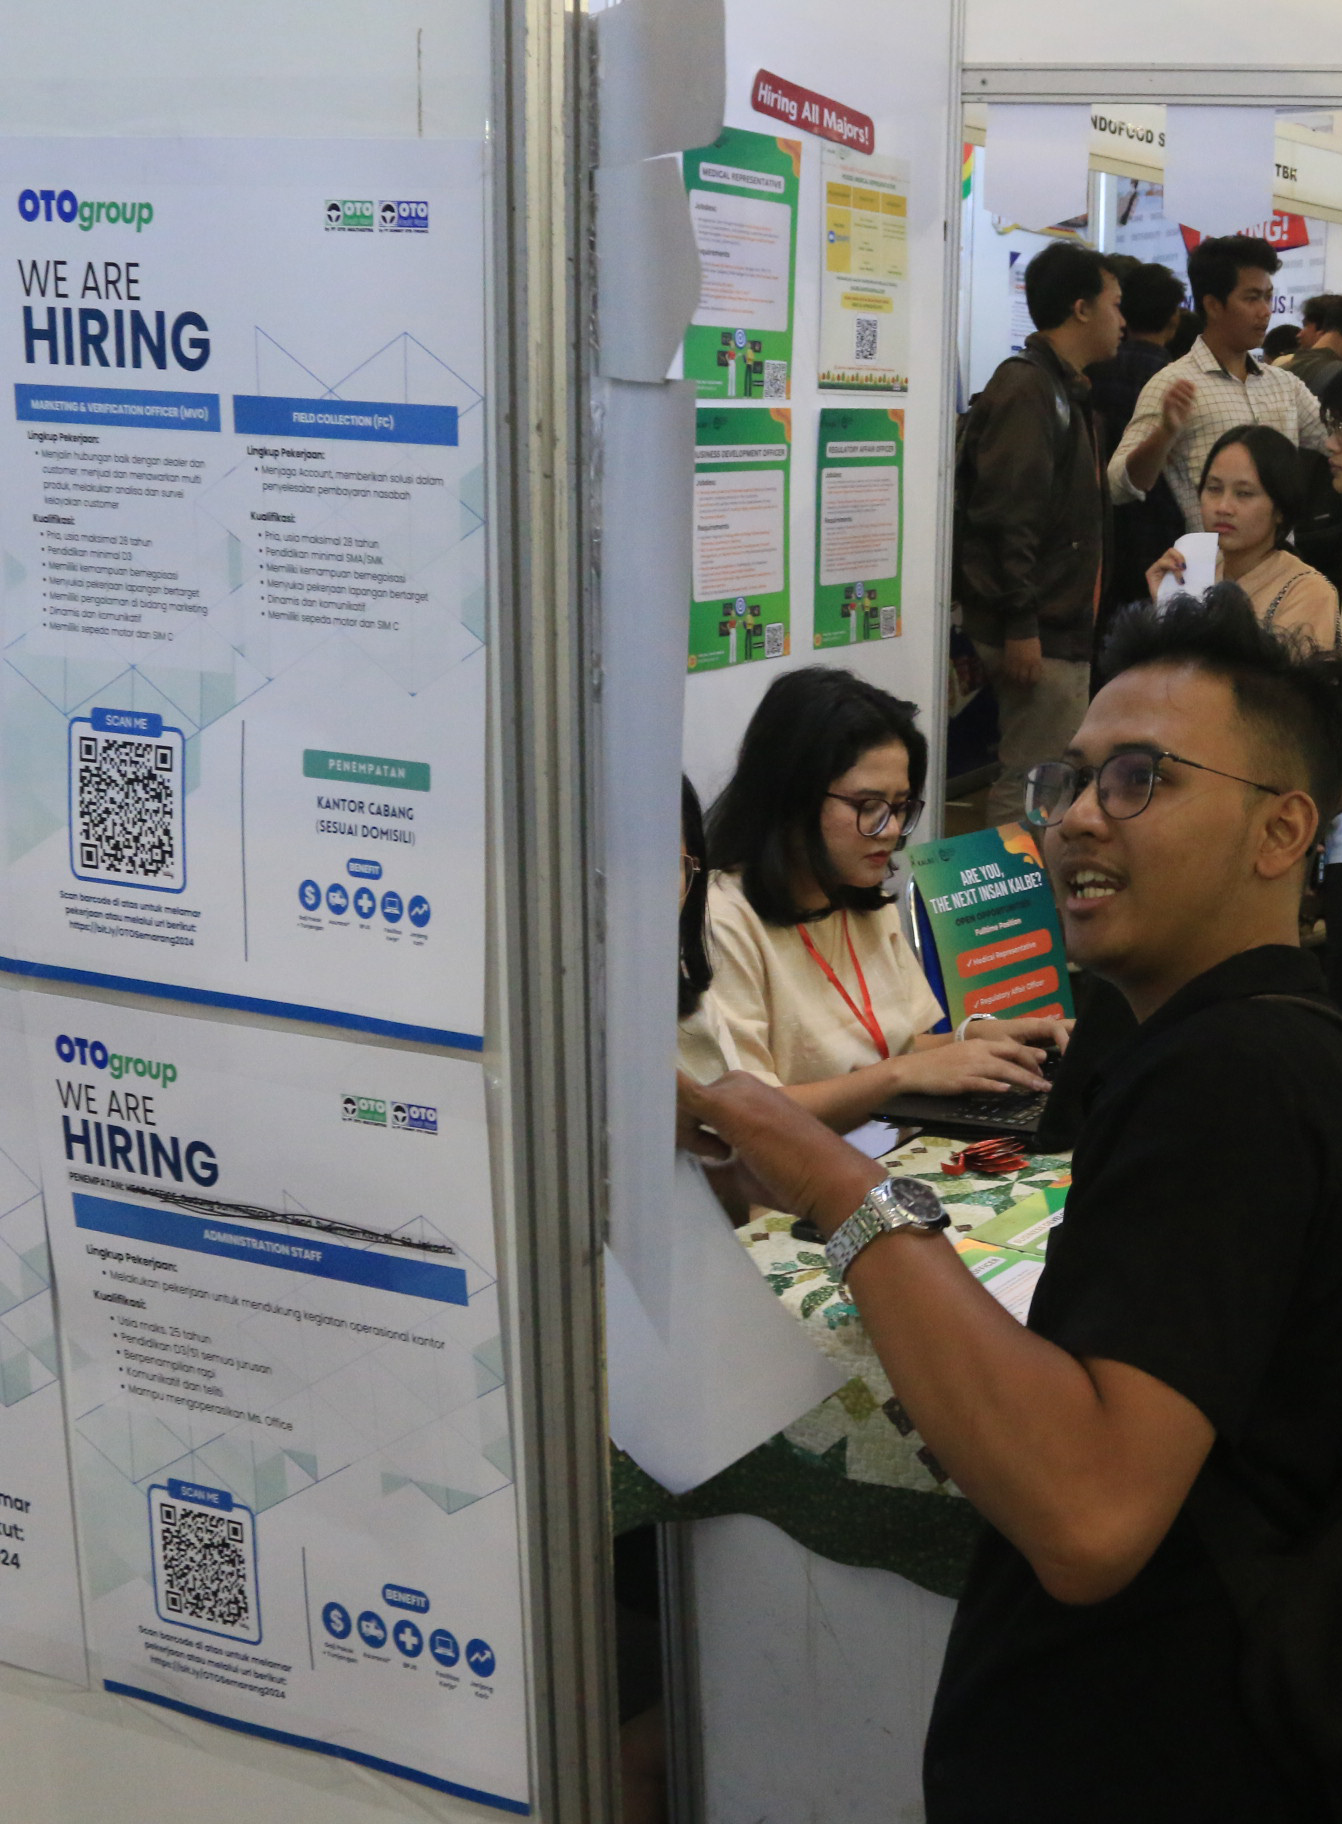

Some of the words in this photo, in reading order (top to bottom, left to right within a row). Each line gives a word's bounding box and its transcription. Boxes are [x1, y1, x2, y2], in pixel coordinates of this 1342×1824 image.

[758, 82, 797, 120] Hiring
[802, 101, 819, 124] All
[823, 108, 869, 144] Majors!
[1158, 132, 1166, 147] S
[703, 168, 730, 179] MEDICAL
[732, 174, 782, 189] REPRESENTATIVE
[1275, 163, 1298, 181] TBK
[18, 188, 154, 232] OTOgroup
[344, 202, 372, 216] OTO
[399, 202, 427, 218] OTO
[18, 259, 69, 298] WE
[81, 262, 141, 301] ARE
[22, 305, 211, 372] HIRING
[30, 399, 79, 411] MARKETING
[78, 402, 86, 412] &
[86, 402, 144, 415] VERIFICATION
[143, 405, 179, 417] OFFICER
[179, 405, 208, 420] (MVO)
[292, 412, 316, 423] FIELD
[315, 413, 372, 426] COLLECTION
[373, 414, 394, 430] (FC)
[246, 446, 279, 459] Lingkup
[280, 448, 324, 460] Pekerjaan:
[721, 450, 761, 458] DEVELOPMENT
[829, 445, 858, 453] REGULATORY
[876, 445, 894, 453] OFFICER
[105, 714, 132, 727] SCAN
[133, 717, 147, 729] ME
[328, 759, 405, 777] PENEMPATAN
[316, 796, 364, 813] KANTOR
[368, 802, 413, 820] CABANG
[316, 819, 357, 836] (SESUAI
[361, 824, 415, 843] DOMISILI)
[348, 862, 381, 874] BENEFIT
[960, 868, 982, 886] ARE
[978, 863, 1004, 881] YOU,
[929, 895, 952, 914] THE
[951, 888, 978, 908] NEXT
[979, 881, 1009, 902] INSAN
[1008, 872, 1042, 894] KALBE?
[999, 918, 1022, 929] Position
[973, 954, 996, 965] Medical
[996, 942, 1036, 958] Representative
[980, 992, 1011, 1005] Regulatory
[1026, 980, 1045, 989] Officer
[56, 1034, 178, 1088] OTOgroup
[56, 1079, 97, 1114] WE
[107, 1090, 156, 1126] ARE
[358, 1098, 386, 1113] OTO
[409, 1106, 436, 1122] OTO
[62, 1114, 219, 1187] HIRING
[203, 1230, 290, 1254] ADMINISTRATION
[290, 1246, 321, 1261] STAFF
[86, 1245, 124, 1262] Lingkup
[125, 1252, 177, 1272] Pekerjaan:
[109, 1270, 160, 1288] Melakukan
[162, 1282, 210, 1298] pekerjaan
[212, 1294, 239, 1305] untuk
[241, 1299, 302, 1321] mendukung
[302, 1311, 347, 1327] kegiatan
[349, 1322, 409, 1341] operasional
[411, 1334, 444, 1349] kantor
[182, 1380, 201, 1391] dan
[0, 1493, 31, 1513] mar
[180, 1486, 206, 1499] SCAN
[205, 1492, 219, 1503] ME
[385, 1588, 425, 1607] BENEFIT
